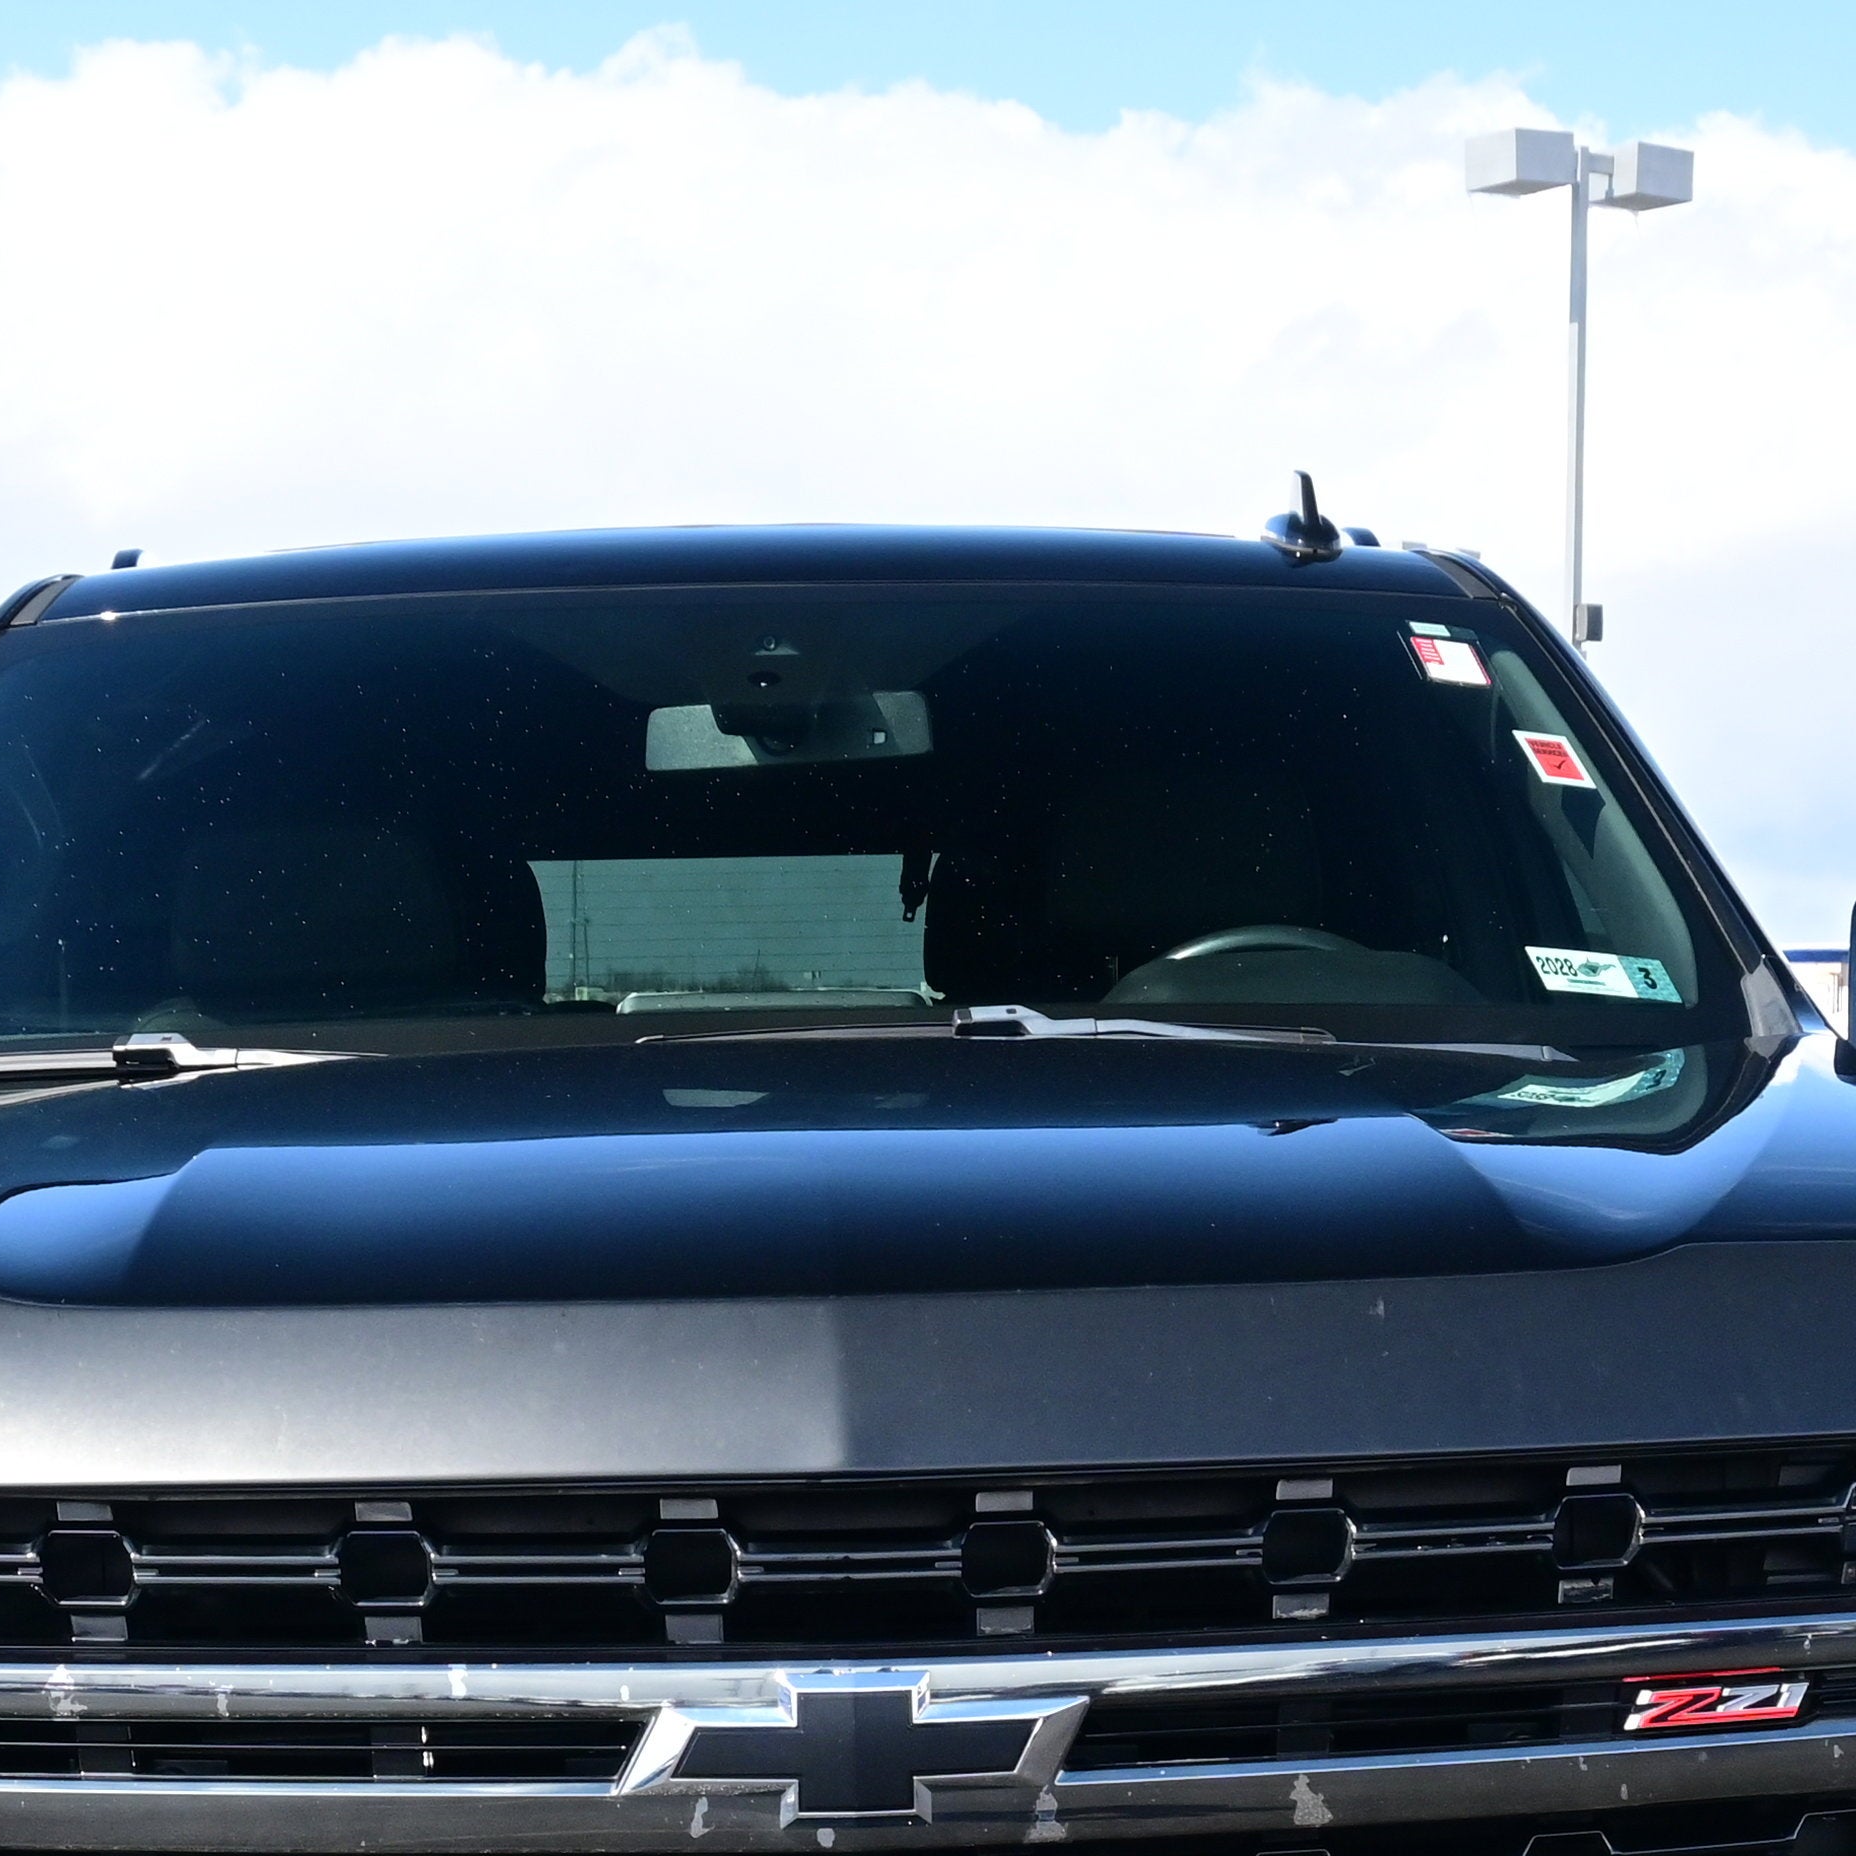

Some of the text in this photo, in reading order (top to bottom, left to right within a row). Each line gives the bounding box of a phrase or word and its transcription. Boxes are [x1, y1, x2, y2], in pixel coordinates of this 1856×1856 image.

[1535, 955, 1579, 977] 2028
[1637, 966, 1658, 990] 3
[1622, 1681, 1810, 1731] Z71
